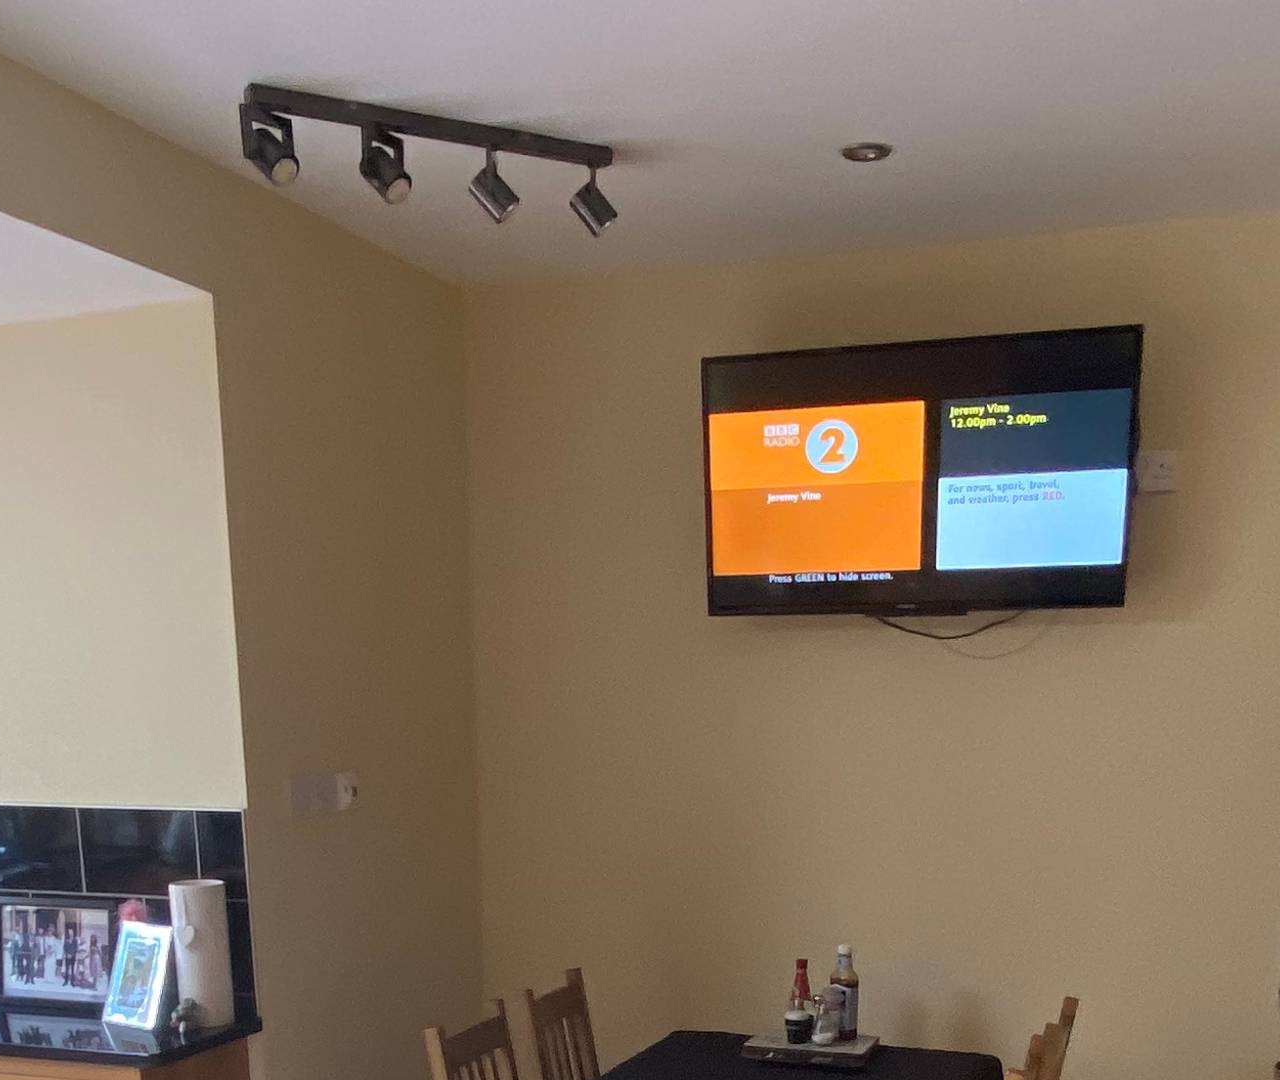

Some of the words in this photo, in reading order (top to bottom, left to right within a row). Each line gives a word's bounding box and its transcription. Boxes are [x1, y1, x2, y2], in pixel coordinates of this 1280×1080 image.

[949, 406, 985, 418] Jeremy
[986, 403, 1010, 413] Vine
[951, 417, 997, 429] 12.00pm
[1006, 414, 1048, 426] 2.00pm
[763, 424, 799, 437] BBC
[763, 436, 800, 447] RADIO
[819, 425, 848, 465] 2
[948, 484, 964, 493] For
[767, 492, 800, 504] Jeremy
[800, 490, 822, 501] Vine
[948, 495, 966, 505] and
[1012, 493, 1040, 504] press
[768, 574, 793, 583] Press
[794, 573, 825, 583] GREEN
[826, 572, 837, 582] to
[838, 571, 859, 581] hide
